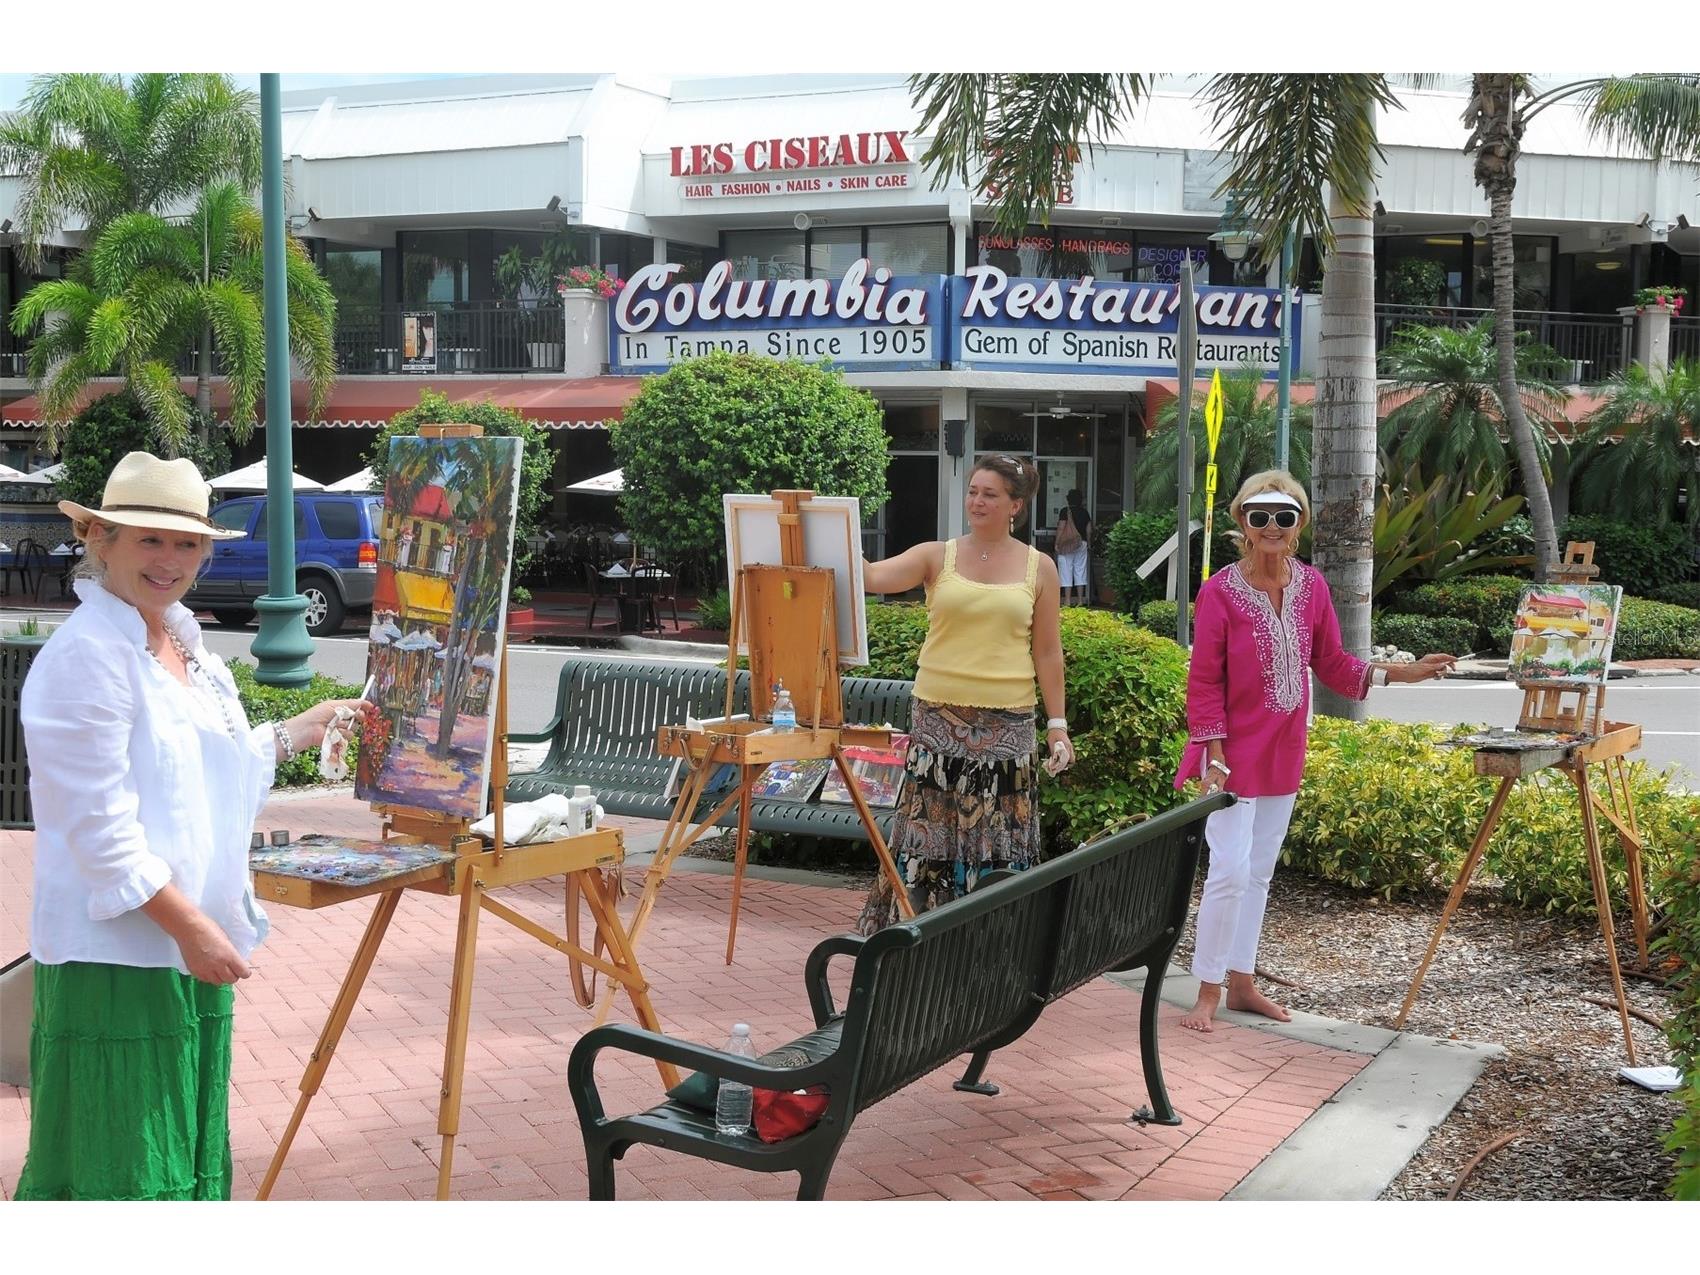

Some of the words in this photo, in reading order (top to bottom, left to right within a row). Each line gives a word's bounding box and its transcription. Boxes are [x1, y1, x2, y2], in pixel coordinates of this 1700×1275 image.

[670, 142, 736, 177] LES
[744, 130, 910, 172] CISEAUX
[685, 185, 714, 198] HAIR
[721, 182, 771, 196] FASHION
[786, 179, 821, 193] NAILS
[840, 176, 869, 190] SKIN
[875, 174, 908, 188] CARE
[614, 257, 929, 333] Columbia
[624, 336, 648, 360] In
[767, 331, 842, 357] Since
[859, 329, 927, 355] 1905
[964, 328, 1018, 355] Gem
[1028, 330, 1051, 356] of
[1062, 331, 1149, 363] Spanish
[1157, 336, 1281, 363] Rtaurants
